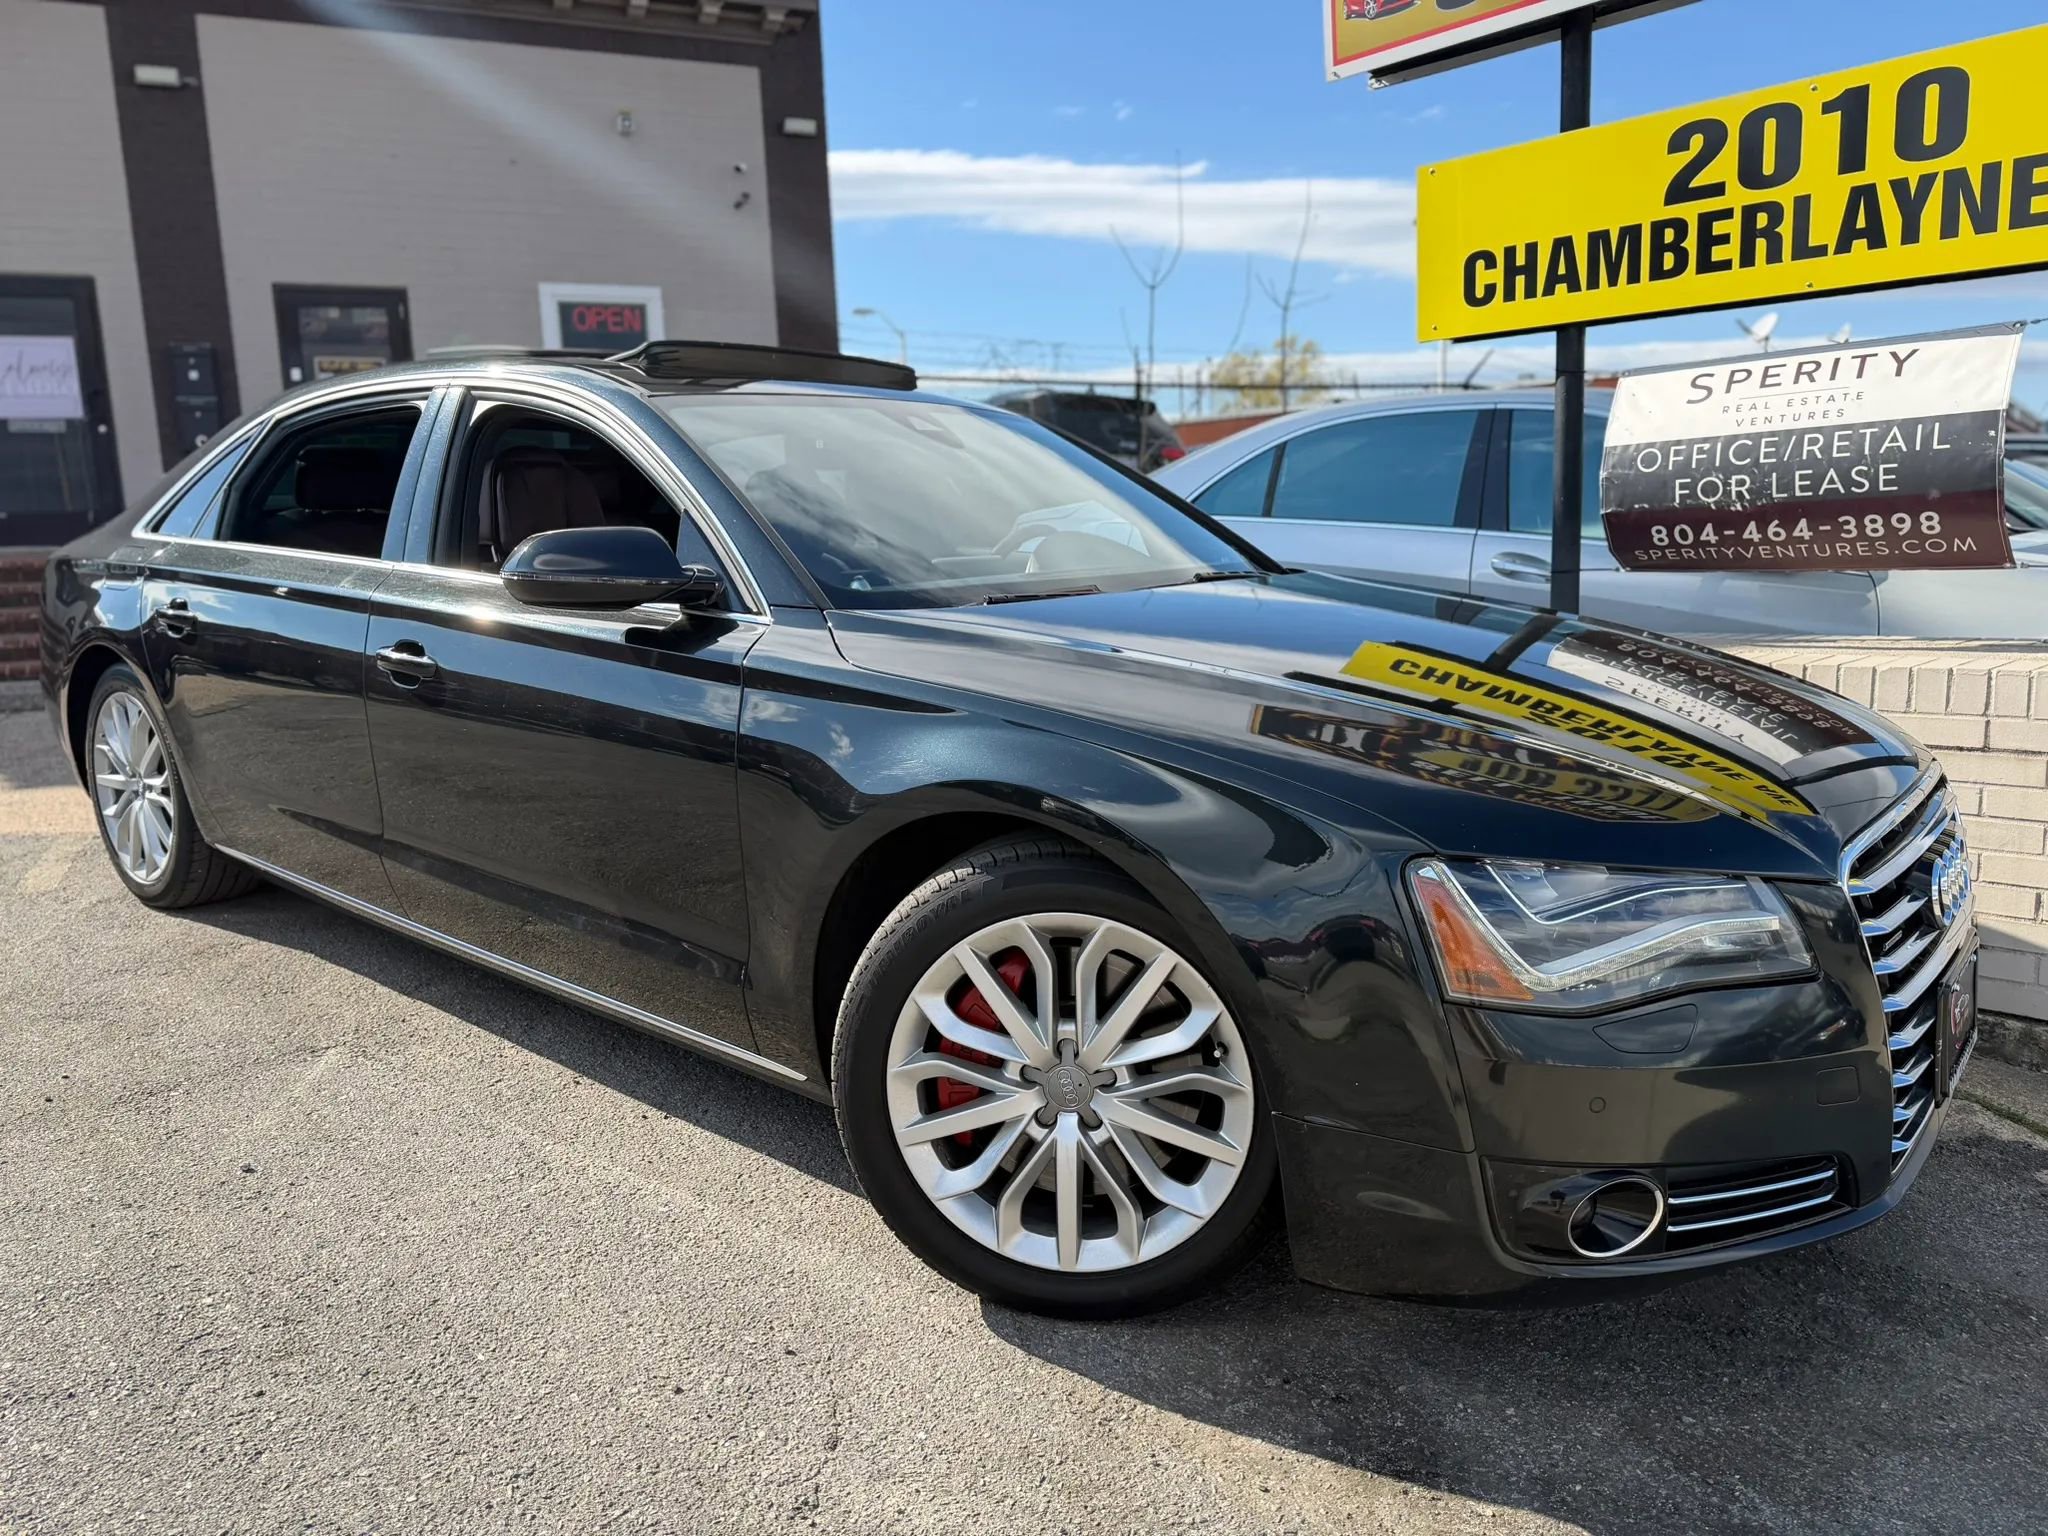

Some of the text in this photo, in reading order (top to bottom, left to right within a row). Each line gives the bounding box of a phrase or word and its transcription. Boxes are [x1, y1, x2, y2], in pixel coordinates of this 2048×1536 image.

[1664, 66, 1970, 207] 2010
[1463, 152, 2048, 308] CHAMBERLAYNE
[572, 304, 642, 333] OPEN
[1686, 348, 1920, 405] SPERITY
[1722, 390, 1865, 414] REAL ESTATE
[1735, 408, 1845, 427] VENTURES
[1636, 422, 1951, 473] OFFICE/RETAIL
[1674, 463, 1899, 503] FOR LEASE
[1650, 511, 1942, 546] 804-464-3898
[1634, 536, 1977, 561] SPERITYVENTURES.COM
